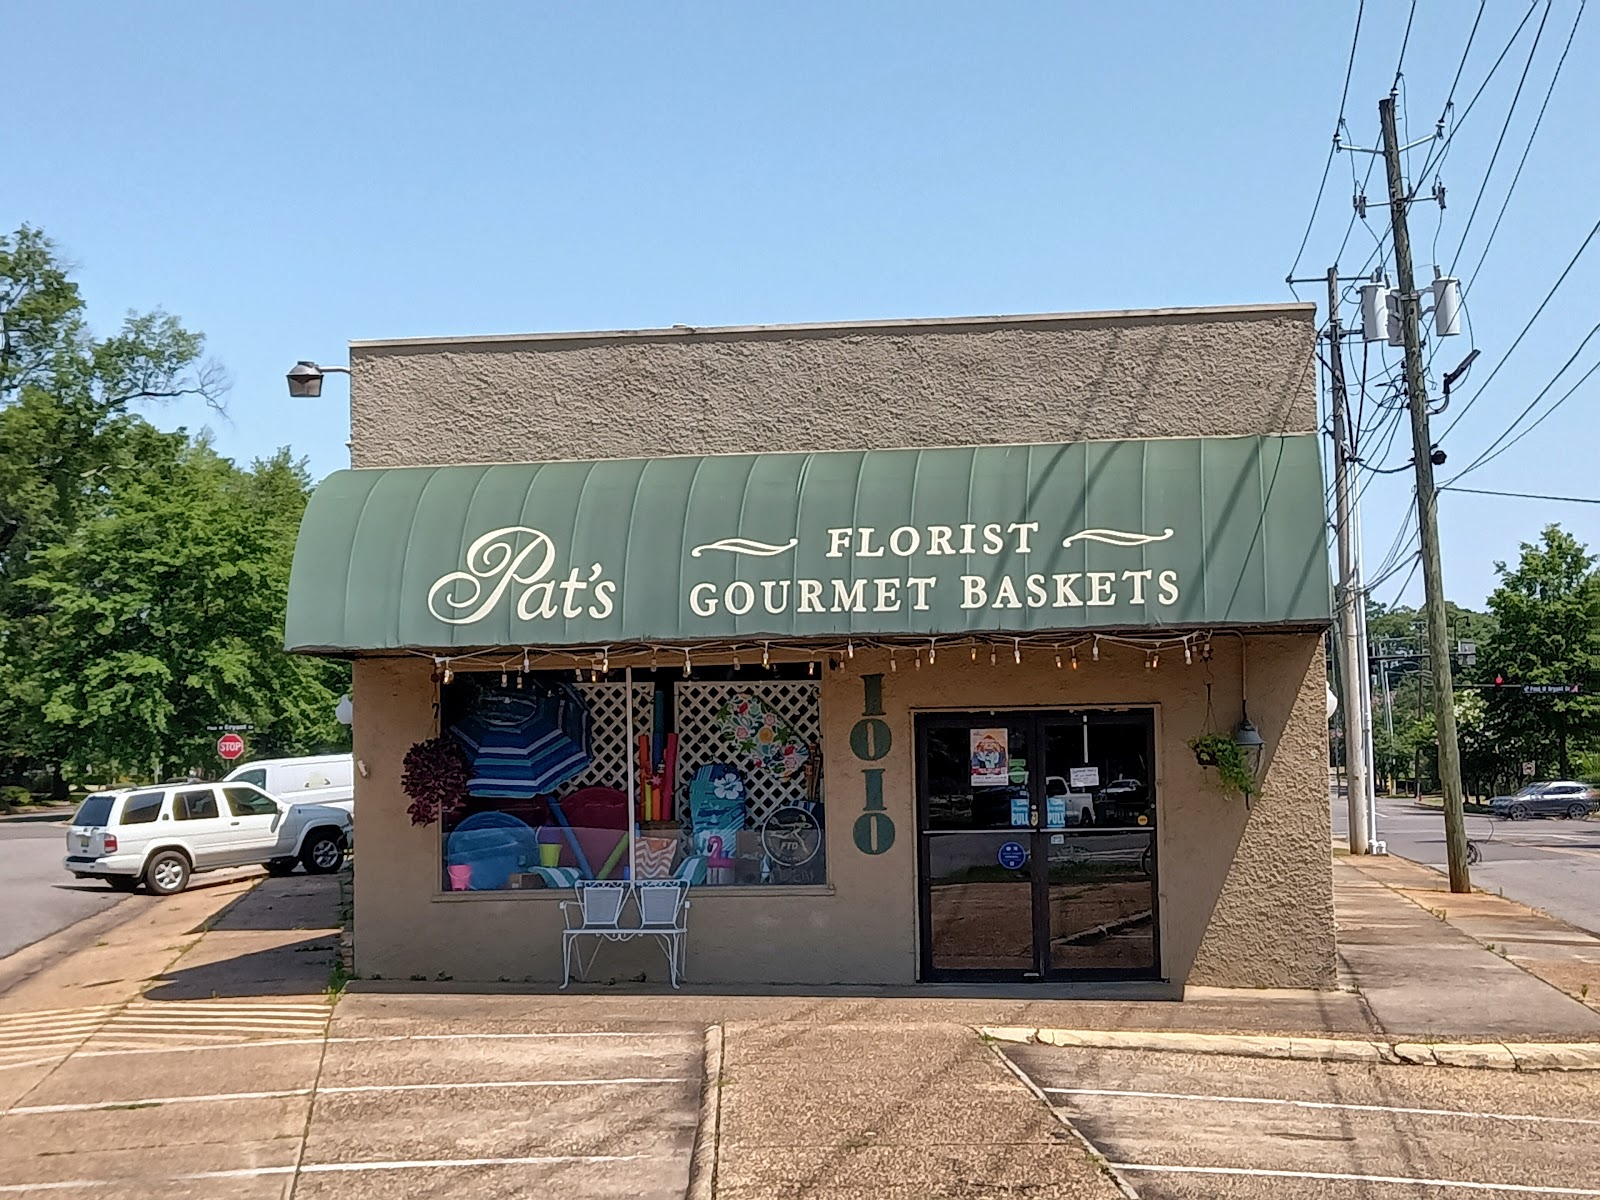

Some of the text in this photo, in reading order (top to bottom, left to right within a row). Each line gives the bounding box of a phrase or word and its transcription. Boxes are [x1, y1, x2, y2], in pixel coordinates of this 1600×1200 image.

[825, 522, 1039, 558] FLORIST
[427, 526, 616, 625] Pat's
[689, 569, 1179, 617] GOURMET BASKETS
[220, 741, 242, 752] STOP
[780, 841, 799, 850] FTD
